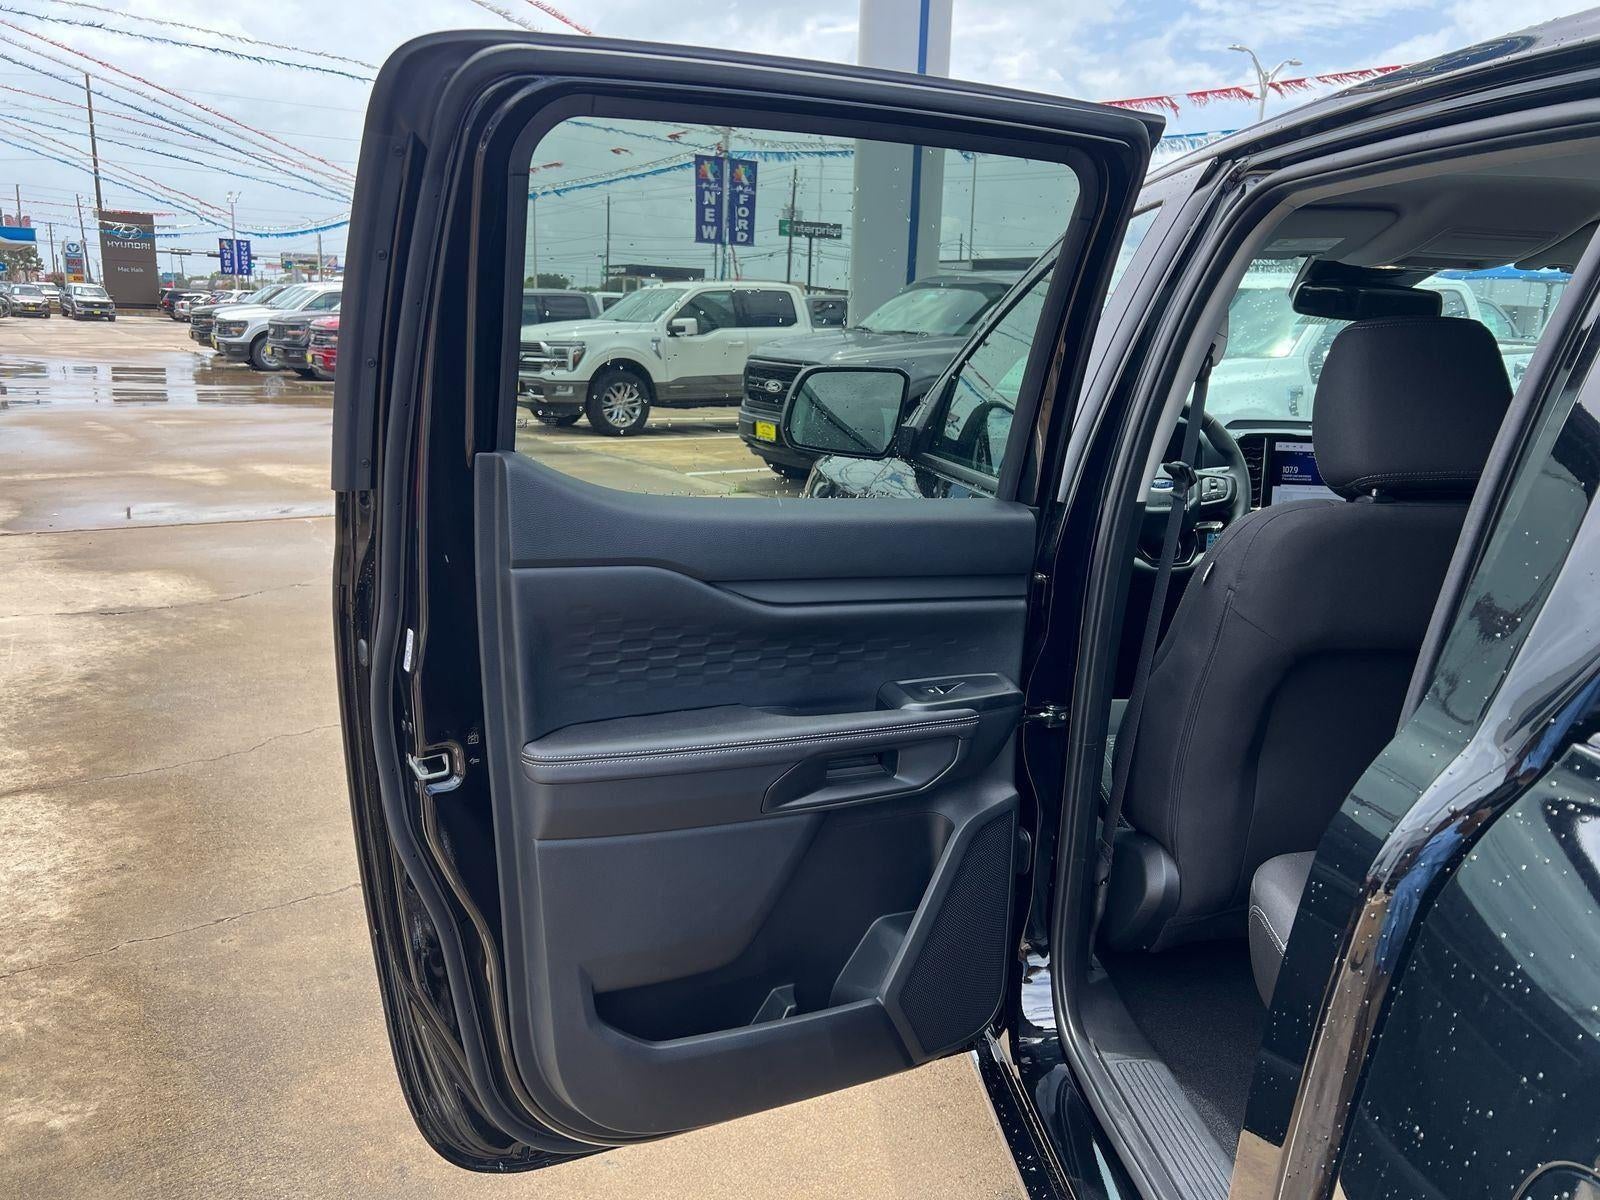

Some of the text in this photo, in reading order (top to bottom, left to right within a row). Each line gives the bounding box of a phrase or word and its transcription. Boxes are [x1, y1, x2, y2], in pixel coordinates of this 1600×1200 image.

[702, 191, 717, 239] NEW
[736, 194, 749, 242] FORD
[107, 240, 151, 250] HYUNDAI
[223, 252, 233, 274] NEW
[1282, 465, 1299, 474] 107.9
